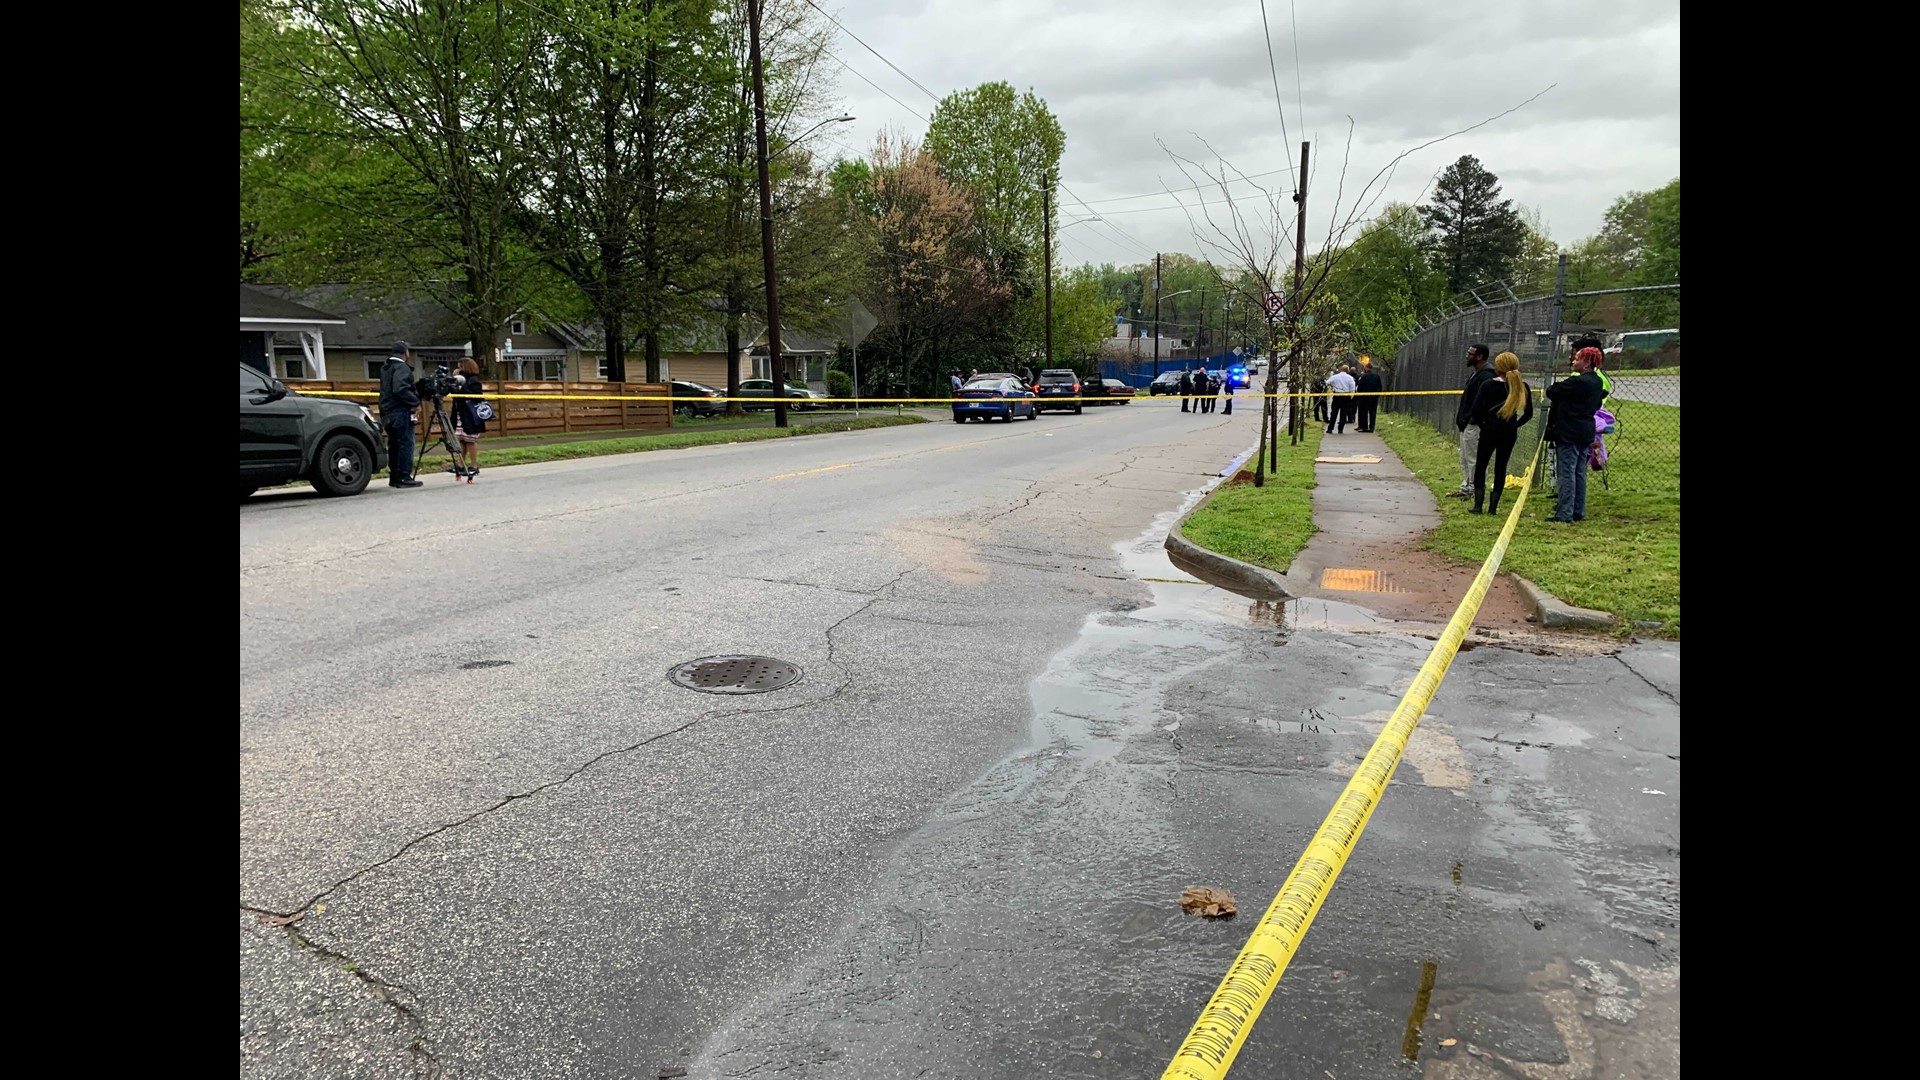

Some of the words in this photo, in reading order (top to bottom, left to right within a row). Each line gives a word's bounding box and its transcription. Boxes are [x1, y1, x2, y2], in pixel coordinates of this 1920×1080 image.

[1232, 952, 1277, 986] CROSS
[1213, 992, 1253, 1016] DO
[1221, 976, 1262, 1004] NOT
[1198, 1006, 1246, 1036] LINE
[1179, 1026, 1234, 1071] POLICE
